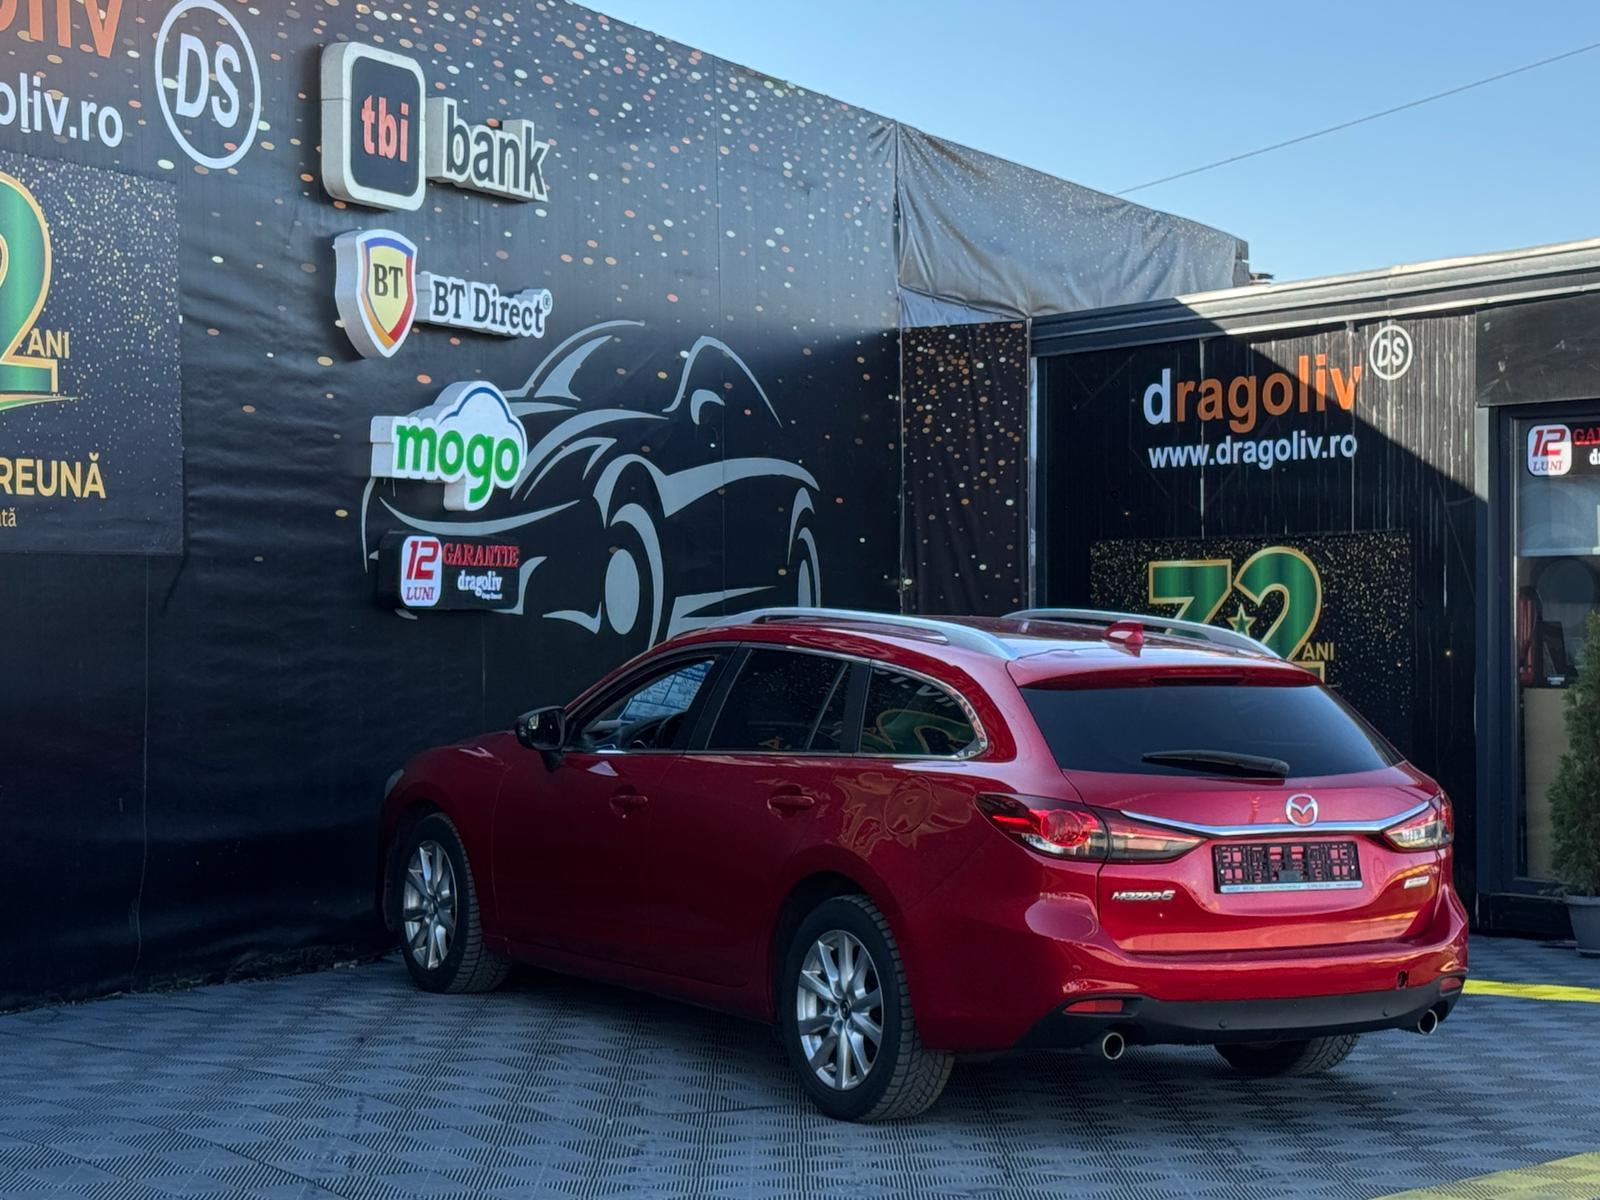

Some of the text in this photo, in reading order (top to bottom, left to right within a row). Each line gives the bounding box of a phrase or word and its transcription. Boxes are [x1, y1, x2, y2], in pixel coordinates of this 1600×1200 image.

[361, 95, 549, 197] tbi bank
[373, 263, 404, 299] BT
[433, 280, 466, 319] BT
[27, 328, 70, 359] ANI
[1143, 353, 1362, 433] dragoliv
[1148, 430, 1358, 470] www.dragoliv.ro
[1532, 428, 1567, 458] 12
[396, 424, 520, 503] mogo
[1533, 460, 1563, 471] LUNI
[0, 507, 17, 527] tă
[406, 540, 439, 580] 12
[443, 543, 519, 568] GARANTIE
[406, 586, 435, 601] LUNI
[457, 569, 503, 597] dragoliv
[1302, 642, 1335, 661] ANI
